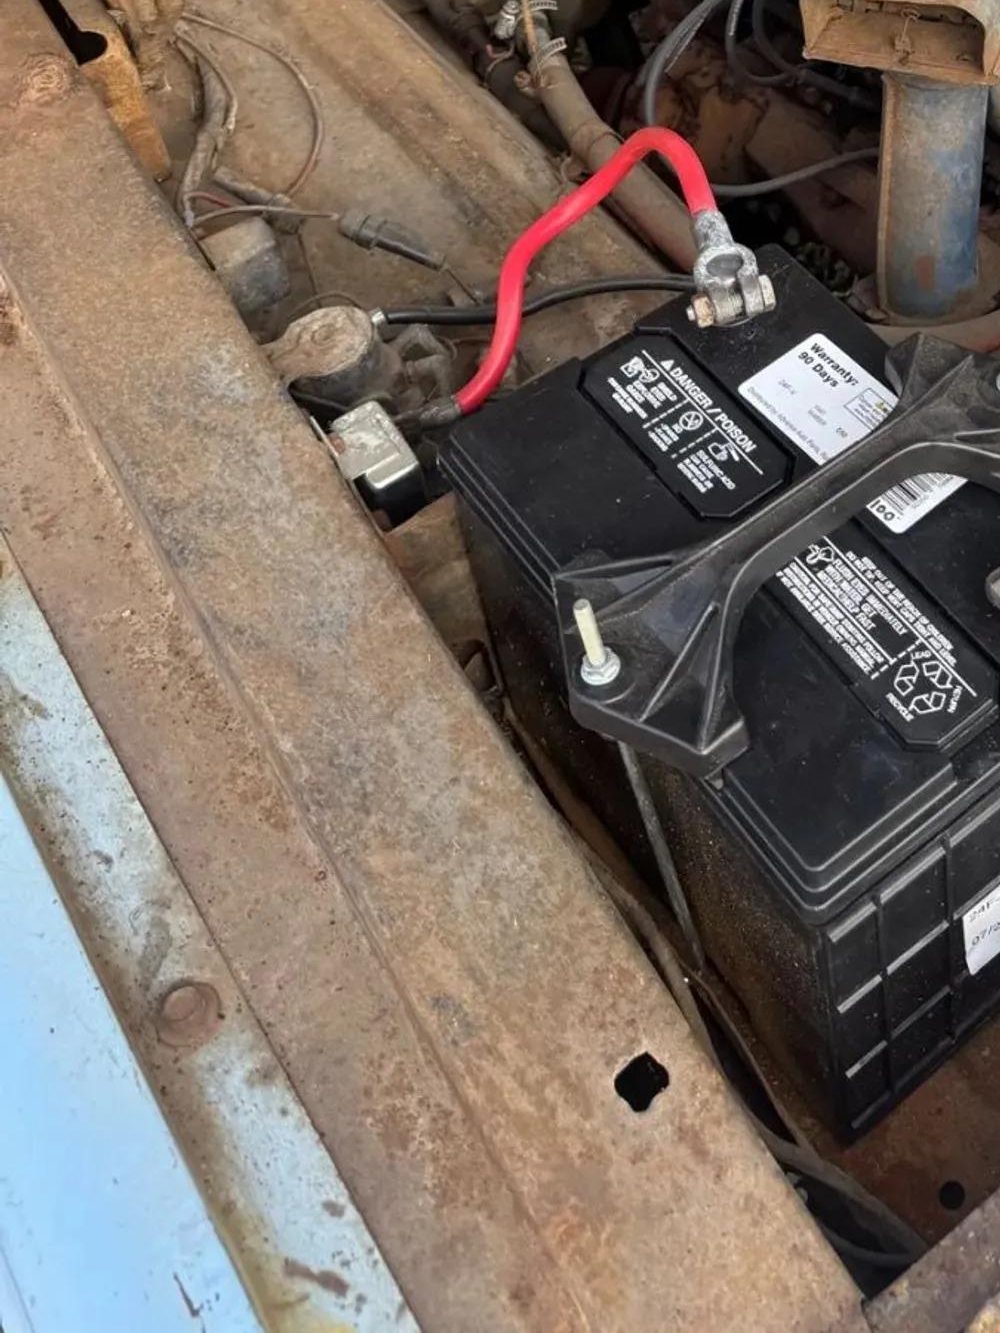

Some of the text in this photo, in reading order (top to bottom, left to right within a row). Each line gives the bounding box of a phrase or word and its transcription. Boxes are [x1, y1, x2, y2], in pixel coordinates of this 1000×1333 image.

[797, 350, 840, 388] 90 Days
[808, 343, 859, 387] Warranty:
[669, 366, 714, 409] DANGER
[714, 412, 757, 453] POISON
